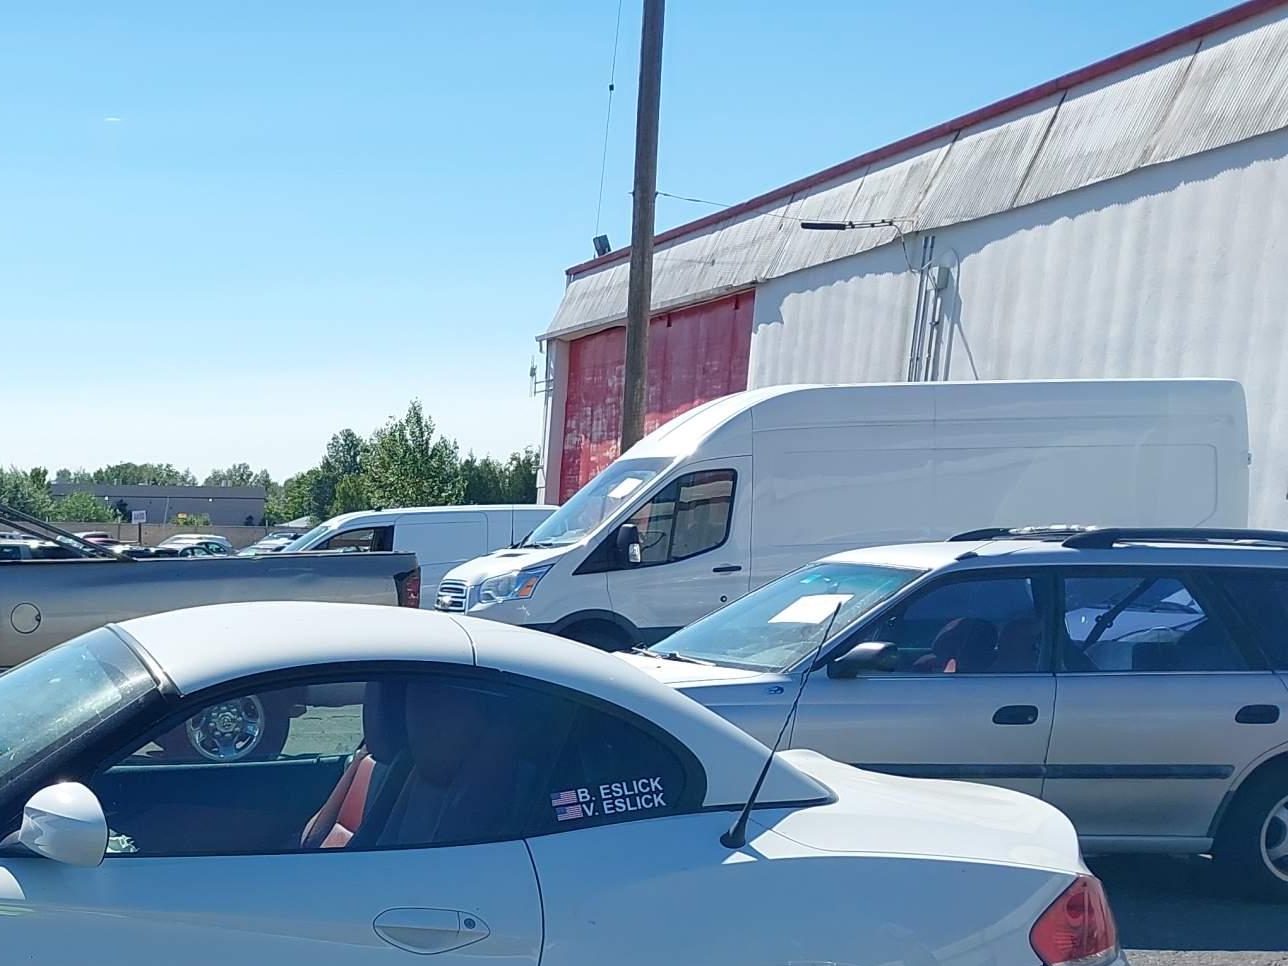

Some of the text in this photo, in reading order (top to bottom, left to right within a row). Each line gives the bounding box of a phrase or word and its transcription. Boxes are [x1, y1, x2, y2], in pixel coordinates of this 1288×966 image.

[577, 776, 664, 803] B. ESLICK
[582, 792, 667, 817] V. ESLICK
